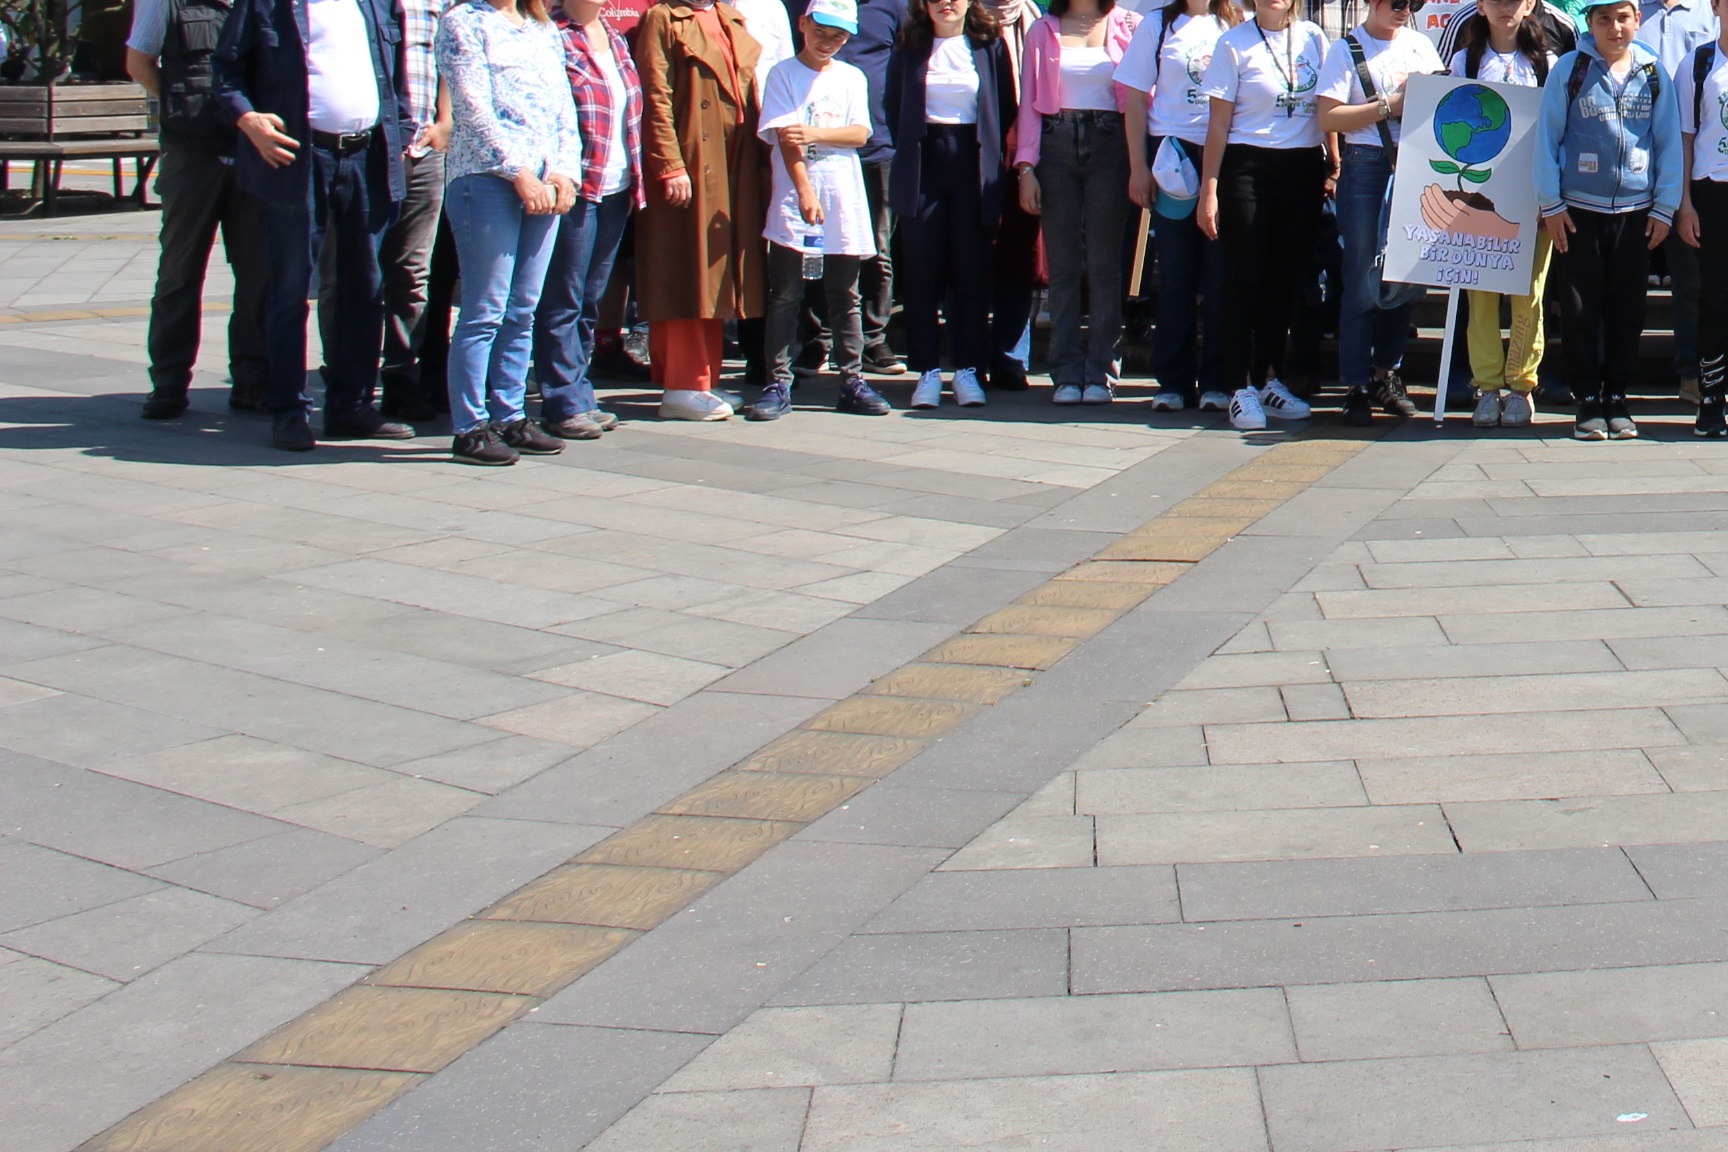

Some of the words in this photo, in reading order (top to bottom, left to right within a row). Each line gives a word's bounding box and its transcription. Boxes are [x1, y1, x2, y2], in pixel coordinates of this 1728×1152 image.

[600, 8, 639, 17] Columbia
[1427, 13, 1451, 29] AC
[1187, 89, 1197, 104] 5
[807, 144, 816, 160] 5
[1718, 136, 1727, 153] 5
[1452, 247, 1514, 270] DÜNYA
